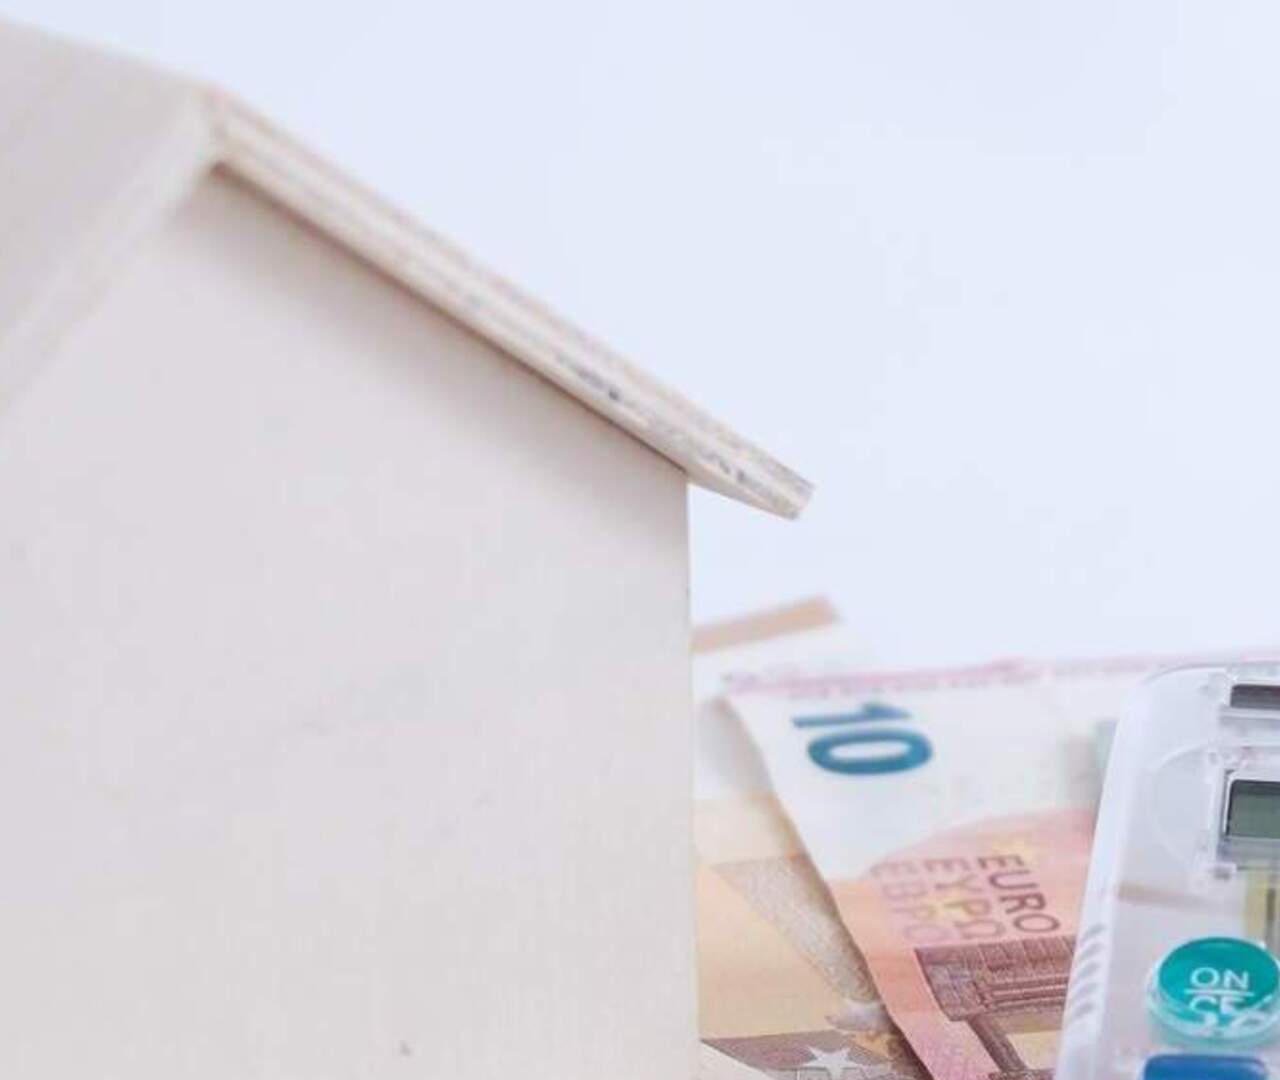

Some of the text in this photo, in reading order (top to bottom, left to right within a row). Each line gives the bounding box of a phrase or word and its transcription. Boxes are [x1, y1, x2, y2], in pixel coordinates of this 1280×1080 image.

[792, 702, 932, 775] 10
[978, 855, 1061, 934] EURO
[1189, 967, 1249, 990] ON
